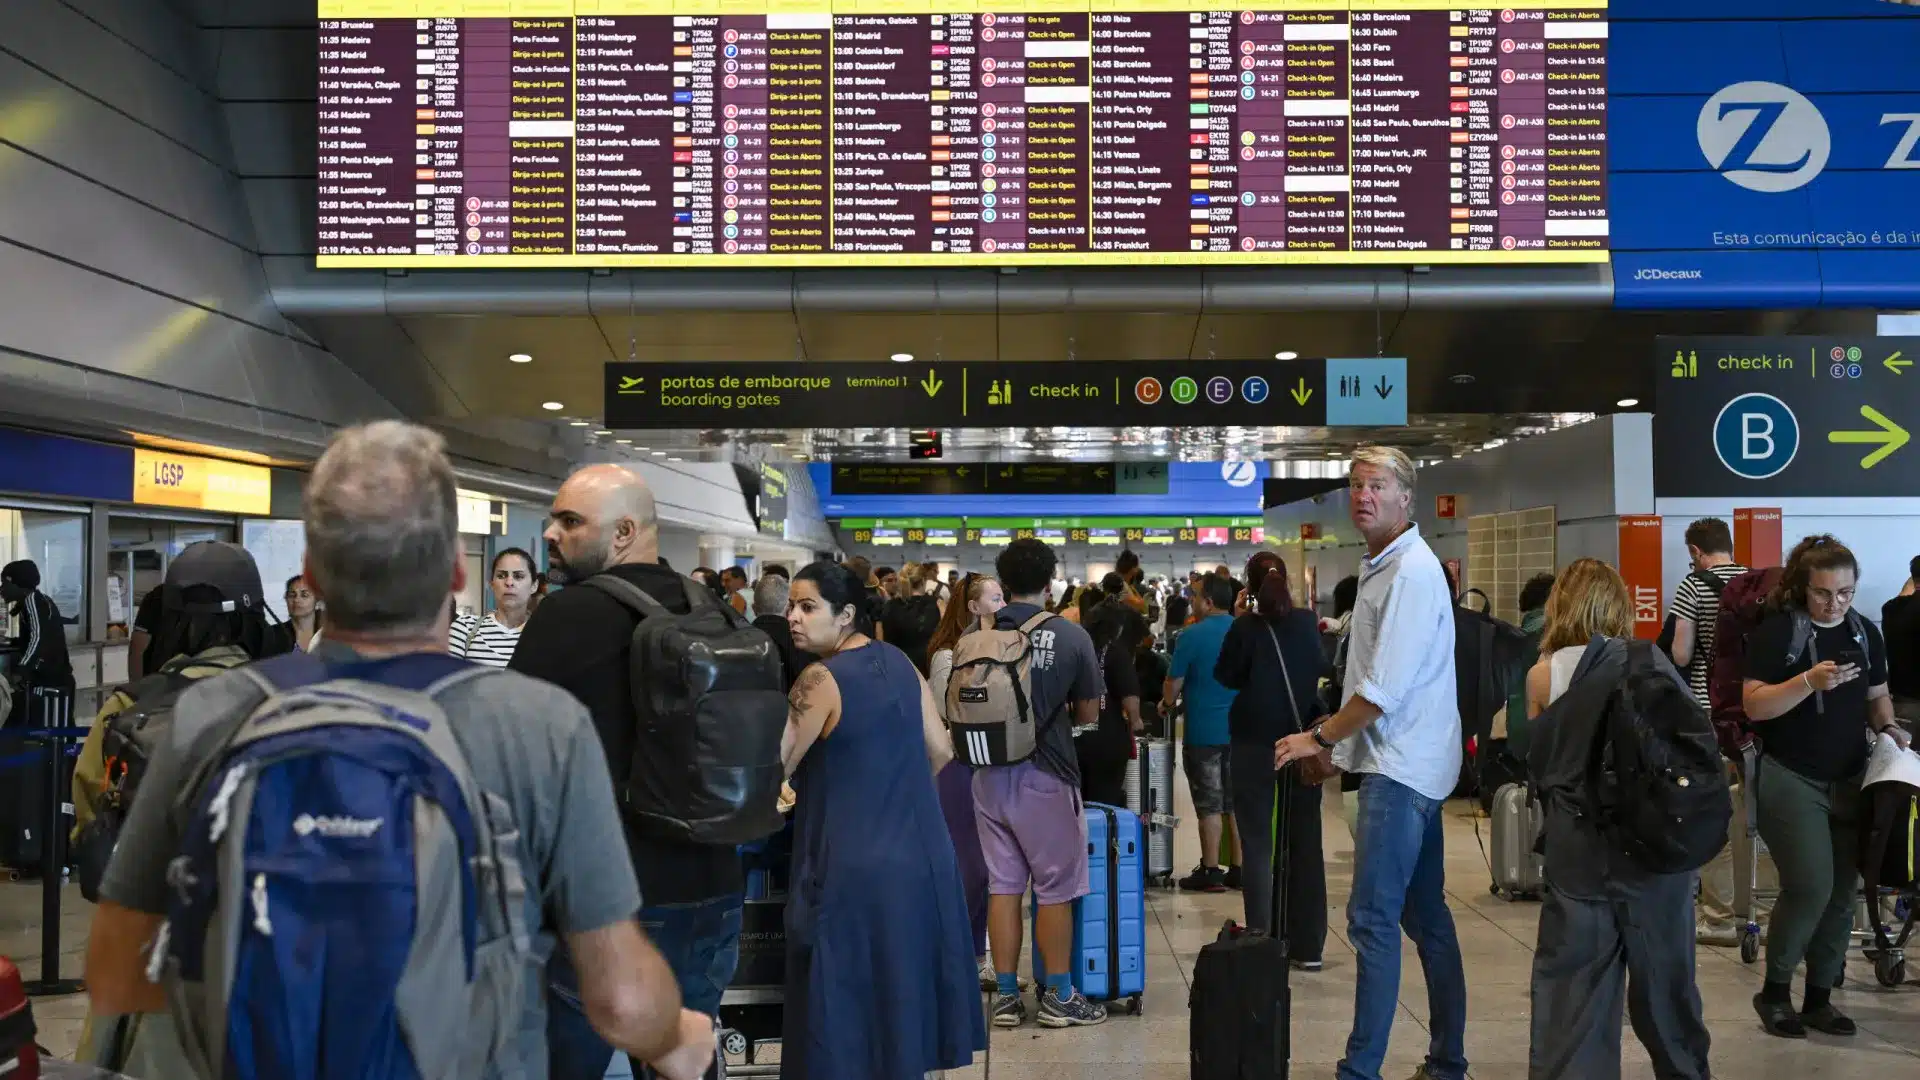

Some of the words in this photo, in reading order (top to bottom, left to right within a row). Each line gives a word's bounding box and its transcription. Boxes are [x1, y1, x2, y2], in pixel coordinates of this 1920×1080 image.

[1351, 13, 1371, 21] 16:30
[1373, 13, 1410, 21] Barcelona
[1352, 28, 1371, 36] 16:30
[1373, 28, 1398, 36] Dublin
[1352, 43, 1371, 52] 16:30
[1373, 43, 1391, 51] Faro
[1352, 58, 1371, 66] 16:35
[1373, 58, 1394, 66] Basel
[1352, 74, 1371, 82] 16:40
[1352, 89, 1371, 97] 16:45
[1373, 89, 1420, 98] Luxemburgo
[1352, 104, 1372, 112] 16:45
[1373, 104, 1399, 112] Madrid
[1352, 134, 1372, 142] 16:50
[1373, 134, 1399, 142] Bristol
[1352, 149, 1372, 158] 17:00
[1391, 149, 1411, 158] York,
[1412, 149, 1427, 157] JFK
[1374, 164, 1395, 173] Paris,
[1396, 164, 1412, 174] Orly
[1352, 194, 1372, 203] 17:00
[1374, 195, 1397, 203] Recife
[1352, 209, 1372, 218] 17:10
[1352, 224, 1372, 233] 17:10
[1713, 231, 1750, 245] Esta
[1754, 229, 1867, 246] comunicação
[1872, 231, 1882, 244] é
[1886, 231, 1907, 244] da
[1352, 240, 1372, 248] 17:15
[1374, 240, 1396, 248] Ponta
[1397, 240, 1427, 250] Delgada
[1633, 268, 1702, 280] JCDecaux
[1718, 353, 1772, 370] check
[1778, 353, 1794, 369] in
[661, 376, 715, 392] portas
[719, 376, 740, 389] de
[744, 376, 831, 392] embarque
[846, 374, 899, 388] terminal
[902, 375, 908, 388] 1
[1030, 383, 1081, 398] check
[1085, 383, 1100, 398] in
[661, 393, 733, 408] boarding
[736, 394, 781, 408] gates
[1742, 412, 1775, 460] B
[154, 460, 184, 486] LGSP
[854, 530, 870, 542] 89
[908, 530, 924, 541] 88
[1071, 530, 1086, 540] 85
[1126, 530, 1142, 540] 84
[1179, 530, 1195, 540] 83
[1235, 530, 1249, 540] 82
[1635, 585, 1658, 622] EXIT
